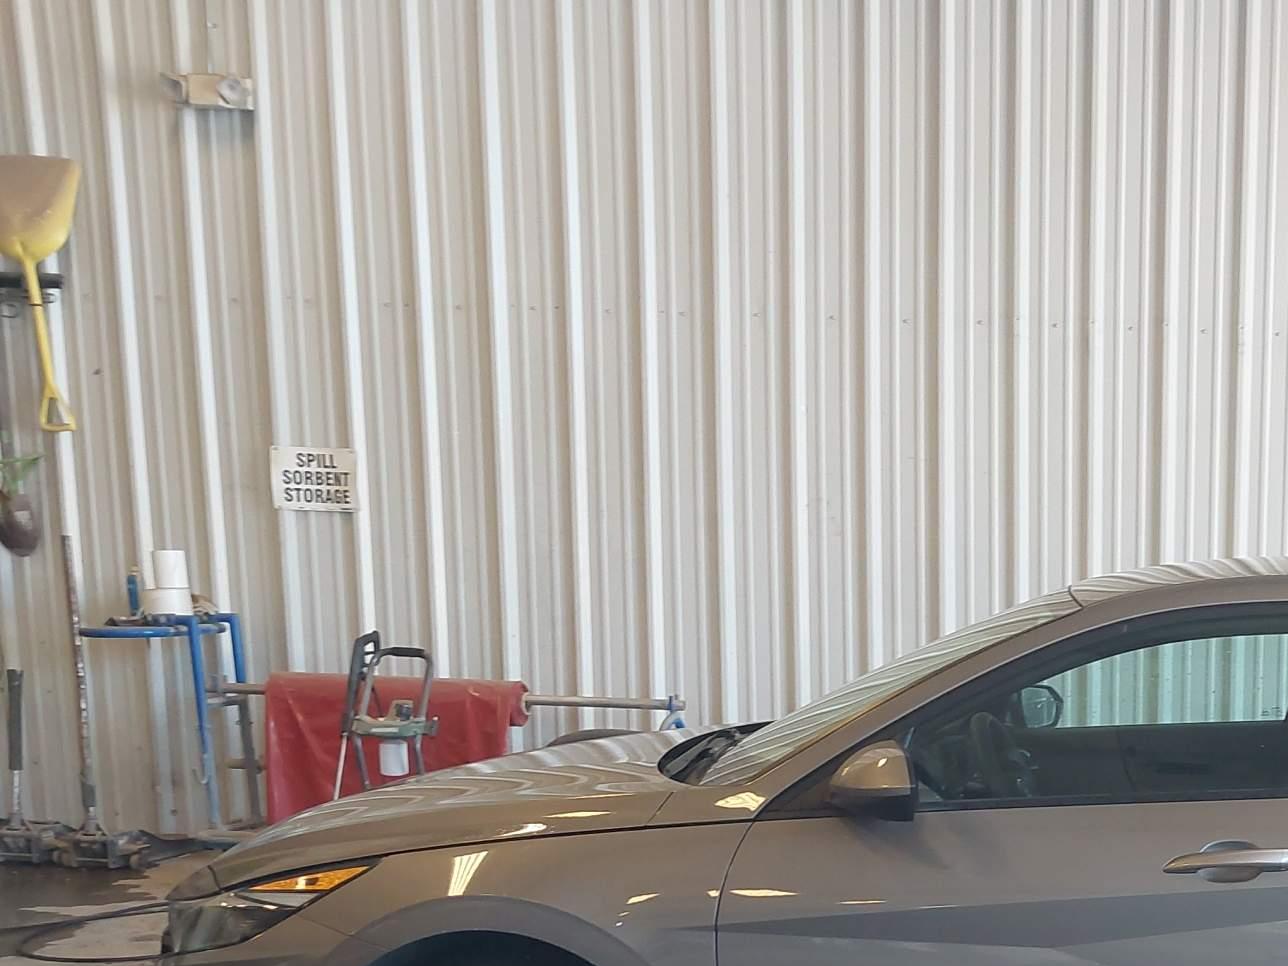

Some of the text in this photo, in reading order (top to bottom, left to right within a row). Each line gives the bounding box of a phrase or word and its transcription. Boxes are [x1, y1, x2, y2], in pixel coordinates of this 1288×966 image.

[296, 452, 338, 469] SPILL
[282, 469, 350, 487] SORBENT
[284, 487, 352, 504] STORAGE
